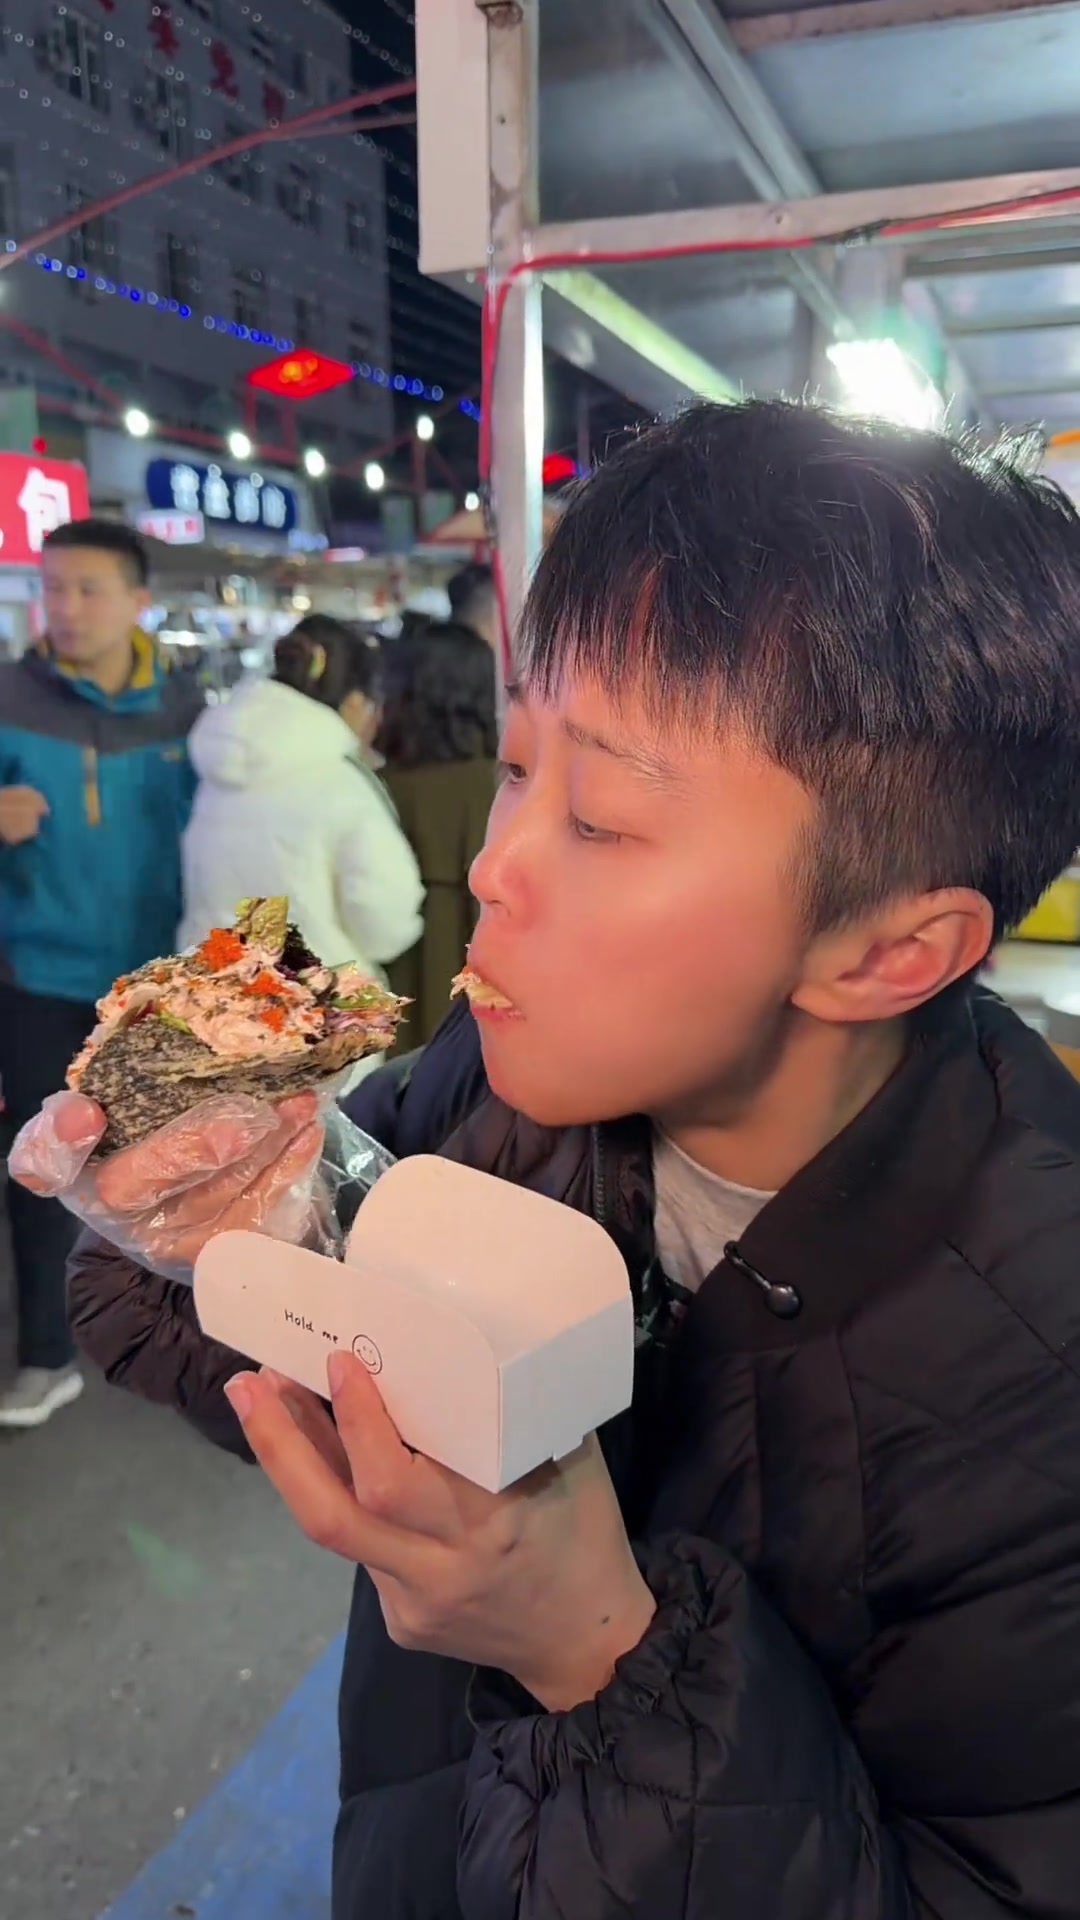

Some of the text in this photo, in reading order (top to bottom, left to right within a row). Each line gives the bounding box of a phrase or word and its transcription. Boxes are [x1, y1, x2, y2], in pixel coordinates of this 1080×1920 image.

[0, 466, 71, 553] 包
[284, 1309, 339, 1344] Hold me
